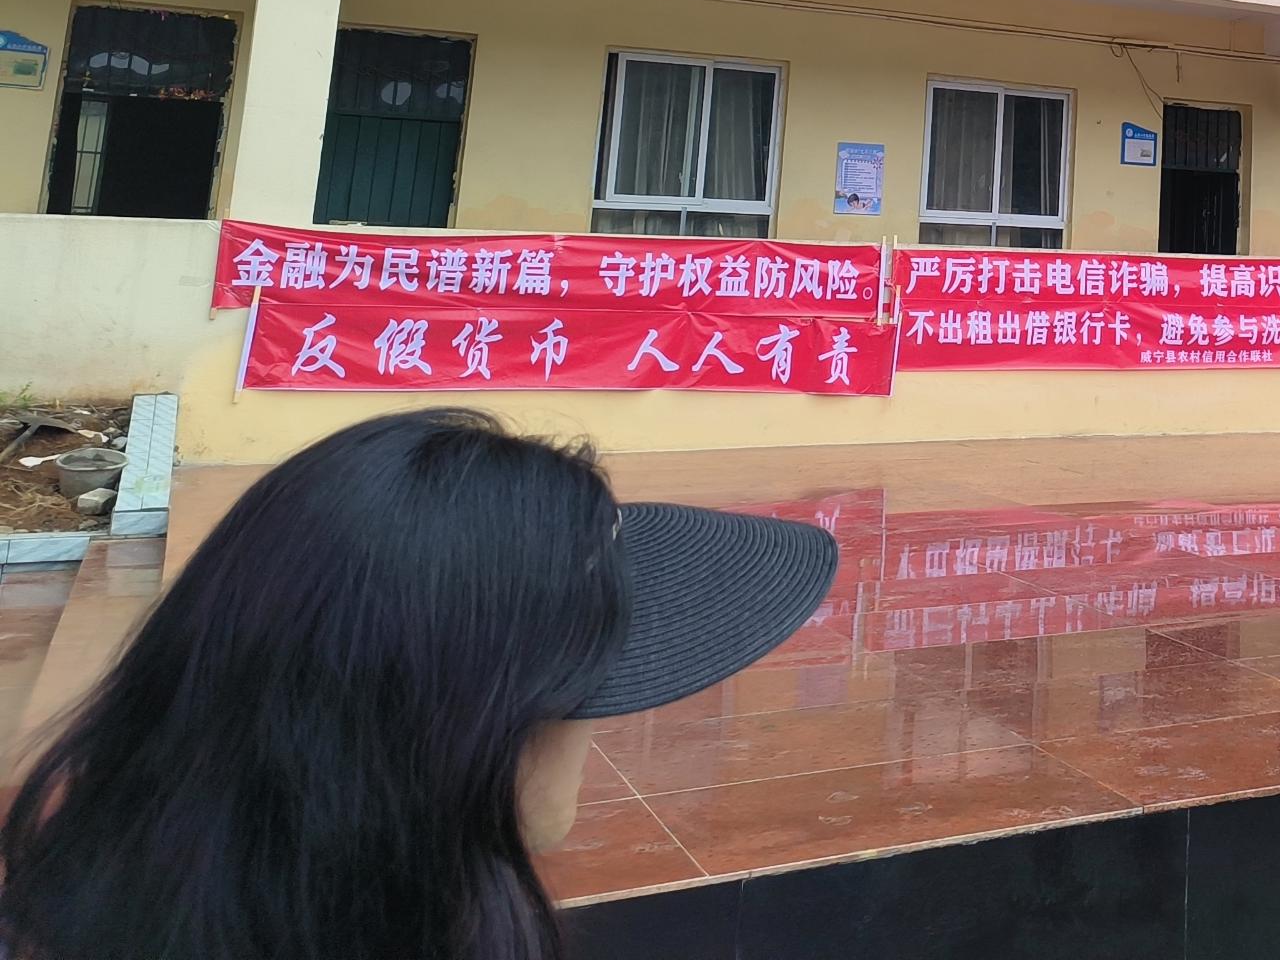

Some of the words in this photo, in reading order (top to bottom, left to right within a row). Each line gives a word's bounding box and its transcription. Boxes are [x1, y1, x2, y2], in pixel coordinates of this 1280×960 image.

[290, 312, 569, 382] 反假货币
[627, 324, 859, 386] 人人有责
